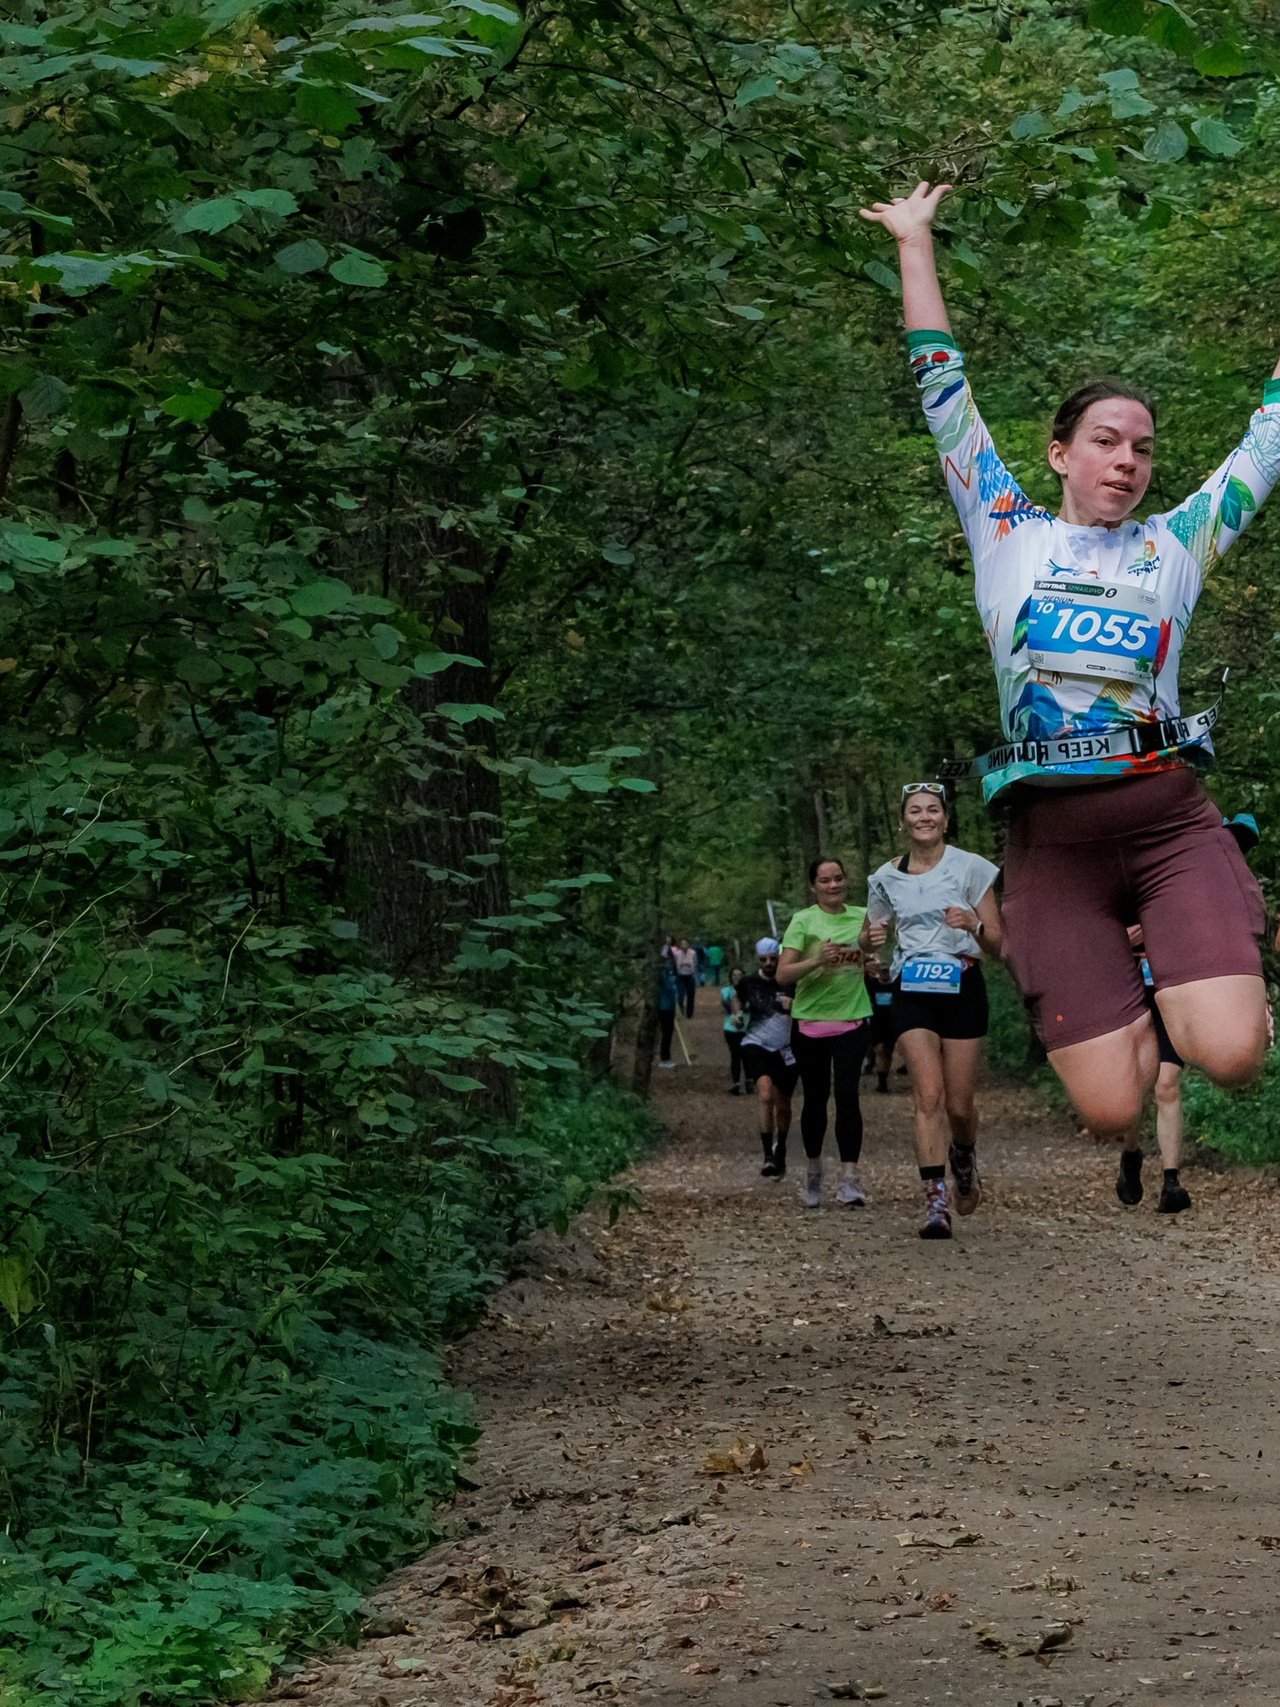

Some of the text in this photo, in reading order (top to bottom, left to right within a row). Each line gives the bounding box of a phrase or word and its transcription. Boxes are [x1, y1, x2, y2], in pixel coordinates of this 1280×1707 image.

[1067, 585, 1103, 595] IZMAILOVO
[1042, 594, 1075, 604] MEDIUM
[1036, 601, 1055, 614] 10
[1051, 608, 1153, 651] 1055
[914, 963, 954, 980] 1192
